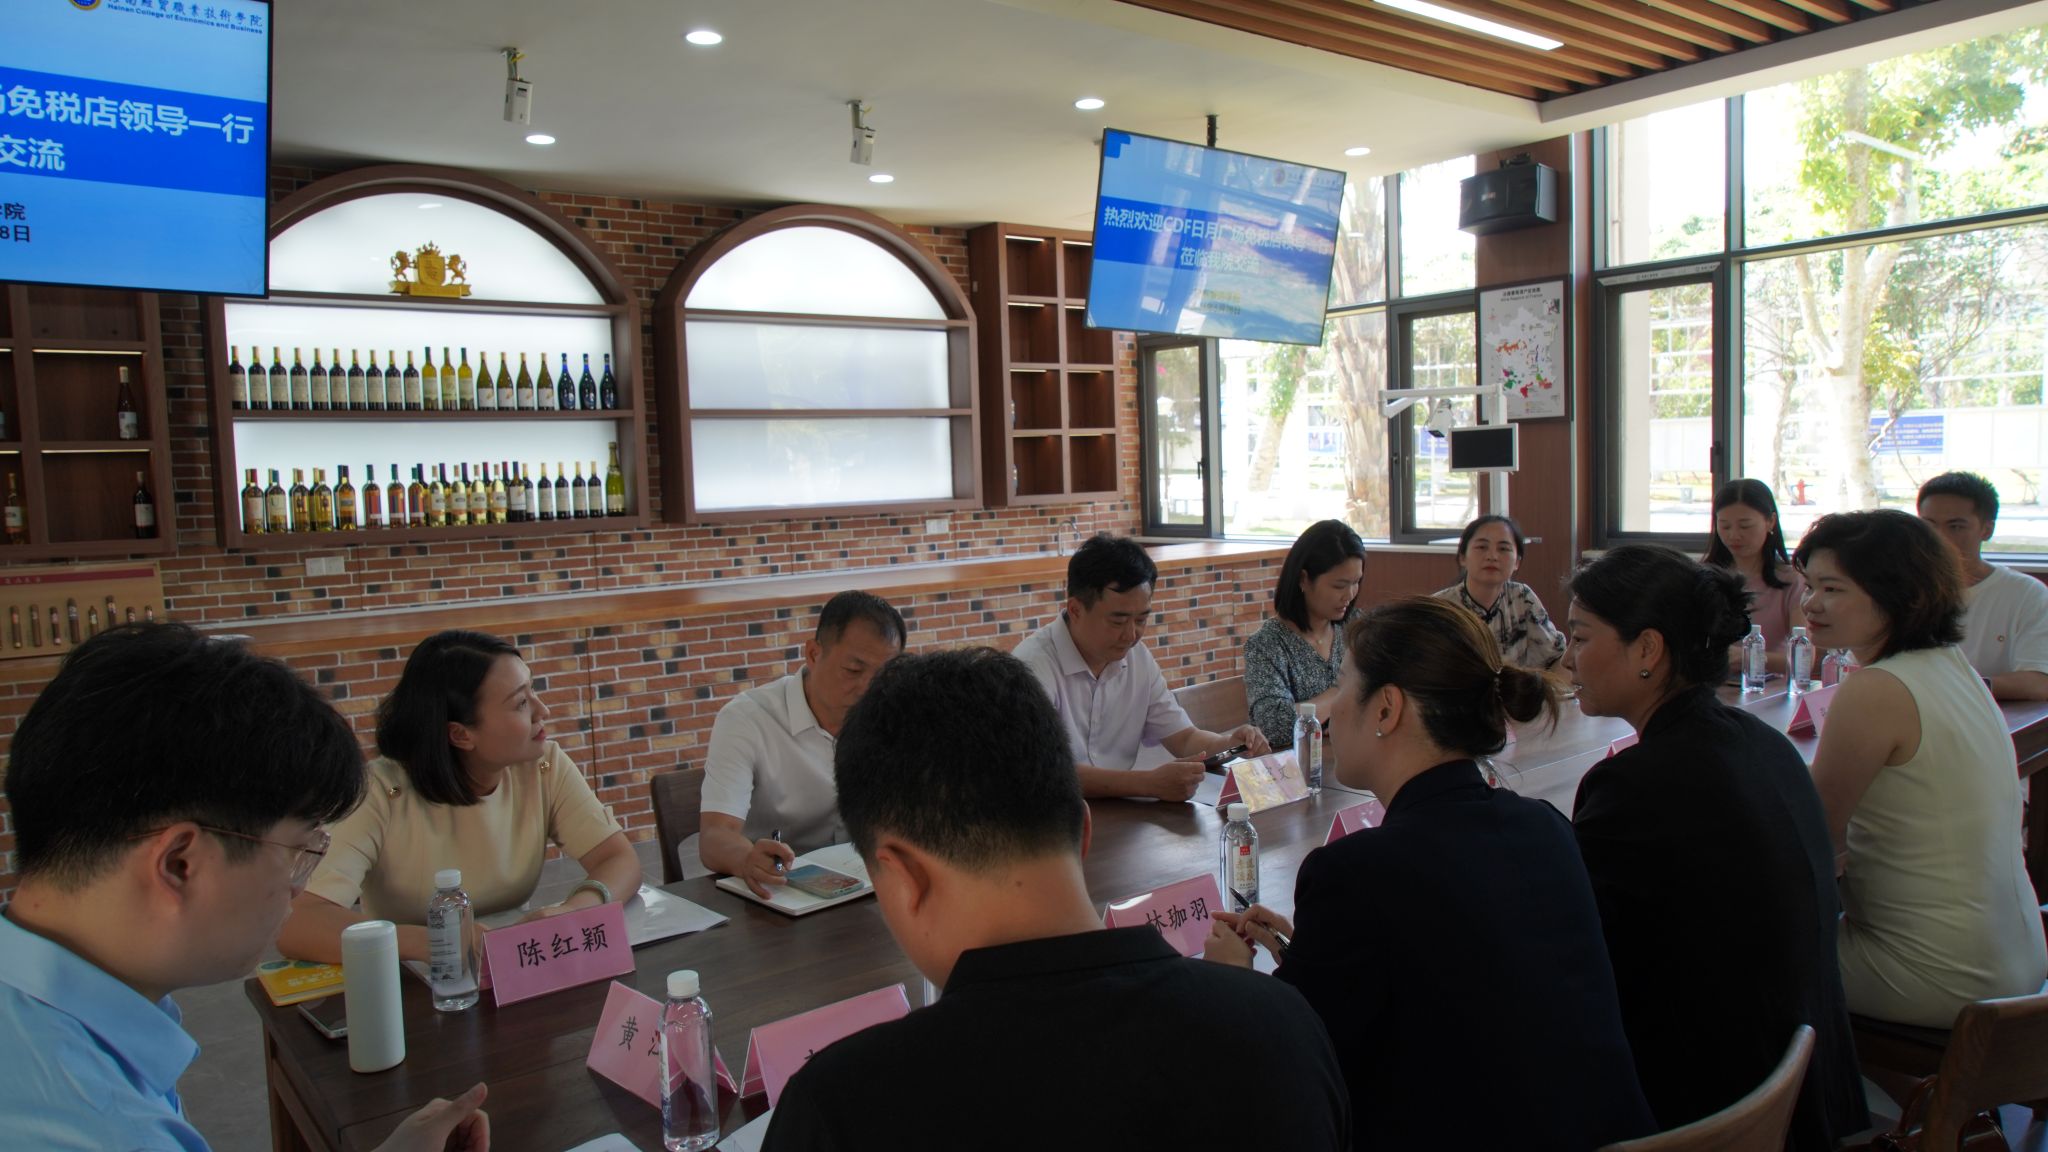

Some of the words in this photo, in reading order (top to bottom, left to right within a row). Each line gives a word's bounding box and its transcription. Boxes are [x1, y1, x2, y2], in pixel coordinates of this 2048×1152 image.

[108, 4, 135, 13] Hainan
[136, 8, 164, 18] College
[174, 14, 215, 26] Economics
[231, 24, 263, 34] Business
[0, 84, 254, 144] 免税店领导一行
[0, 203, 26, 220] 院
[1145, 897, 1209, 934] 林珈羽
[517, 923, 608, 968] 陈红颖
